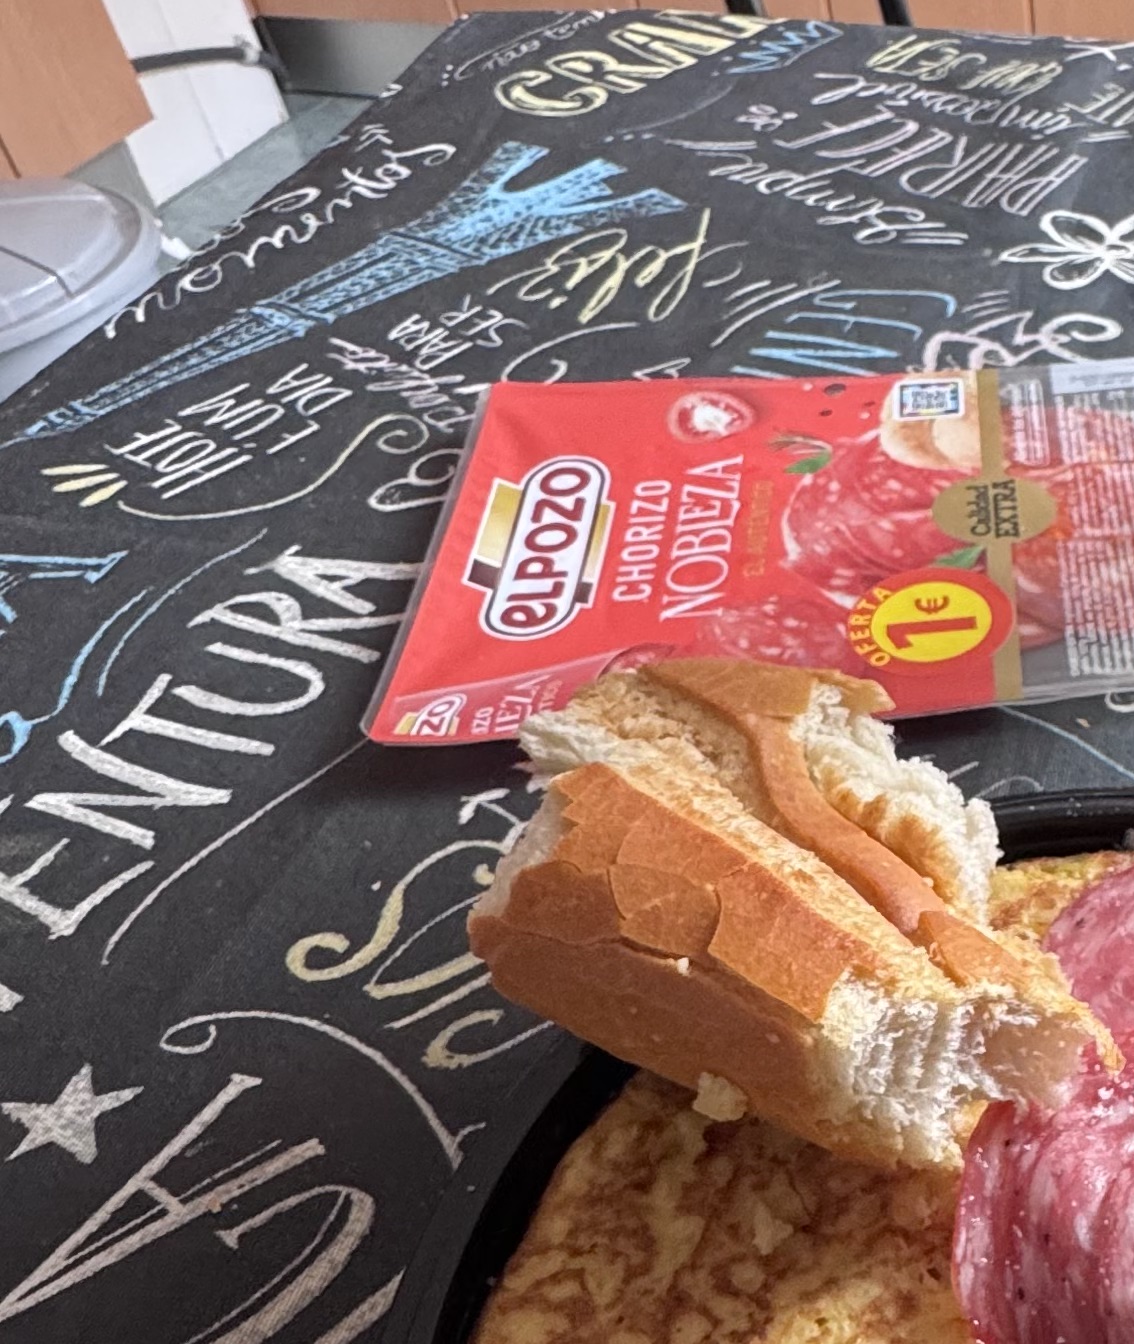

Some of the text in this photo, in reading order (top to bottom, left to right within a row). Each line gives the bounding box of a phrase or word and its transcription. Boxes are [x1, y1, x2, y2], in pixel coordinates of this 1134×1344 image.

[388, 312, 476, 374] PARA
[438, 291, 527, 350] SER
[258, 361, 354, 420] DIA
[103, 428, 255, 501] HOJE
[611, 478, 673, 604] CHORIZO
[659, 453, 745, 623] NOBLEZA
[970, 483, 991, 536] Calidad
[994, 478, 1020, 539] EXTRA
[847, 585, 893, 668] OFERTA
[0, 544, 425, 1012] ENTURA
